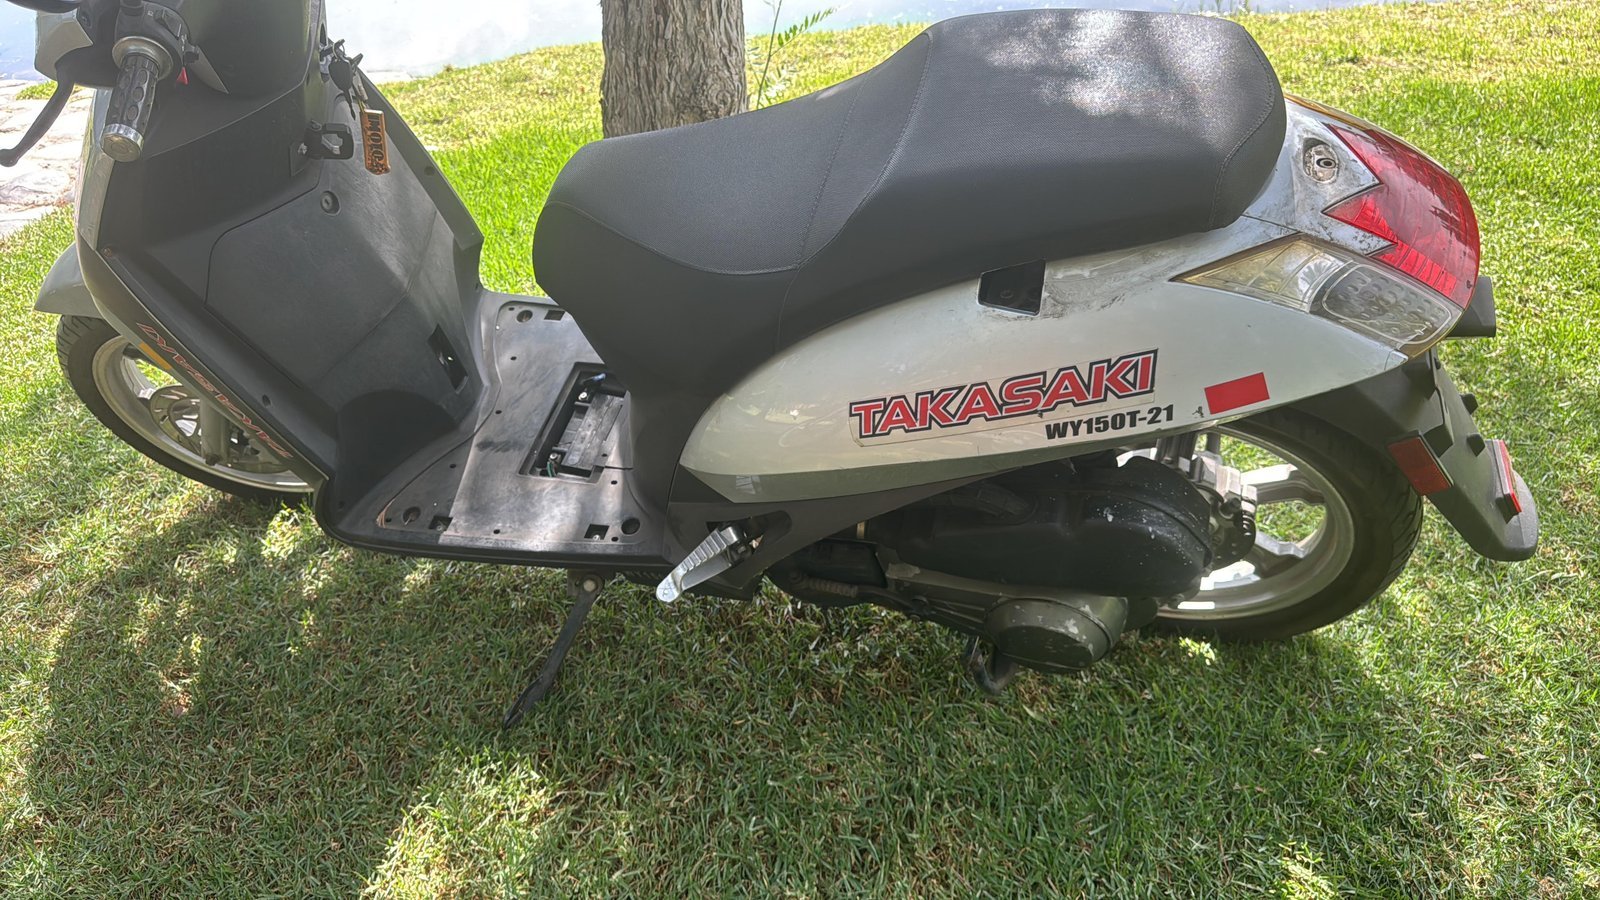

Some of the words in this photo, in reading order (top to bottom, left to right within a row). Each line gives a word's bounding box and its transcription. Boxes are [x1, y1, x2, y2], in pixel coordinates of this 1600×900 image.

[136, 322, 293, 458] TAKASAKI
[849, 349, 1158, 438] TAKASAKI
[1045, 404, 1174, 440] WY150T-21
